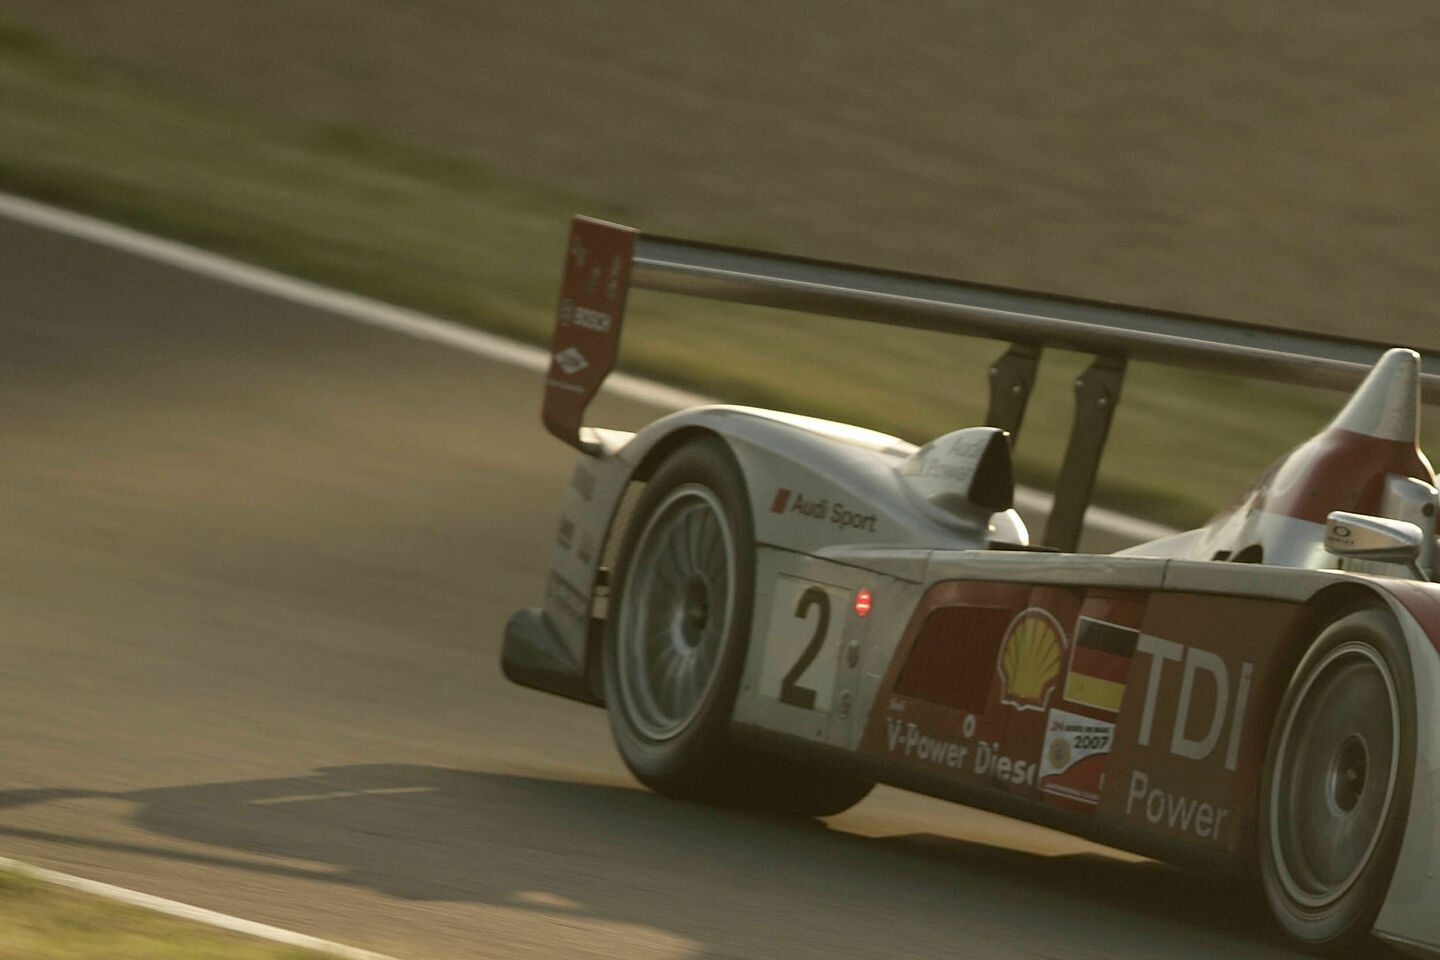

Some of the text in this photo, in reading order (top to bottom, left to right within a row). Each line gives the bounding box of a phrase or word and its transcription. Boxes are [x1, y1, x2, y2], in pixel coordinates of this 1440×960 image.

[791, 494, 878, 532] Audi Sport
[780, 585, 831, 711] 2
[1136, 632, 1254, 771] TDI
[886, 717, 969, 769] V-Power
[1073, 735, 1110, 750] 2007
[1126, 770, 1229, 839] Power
